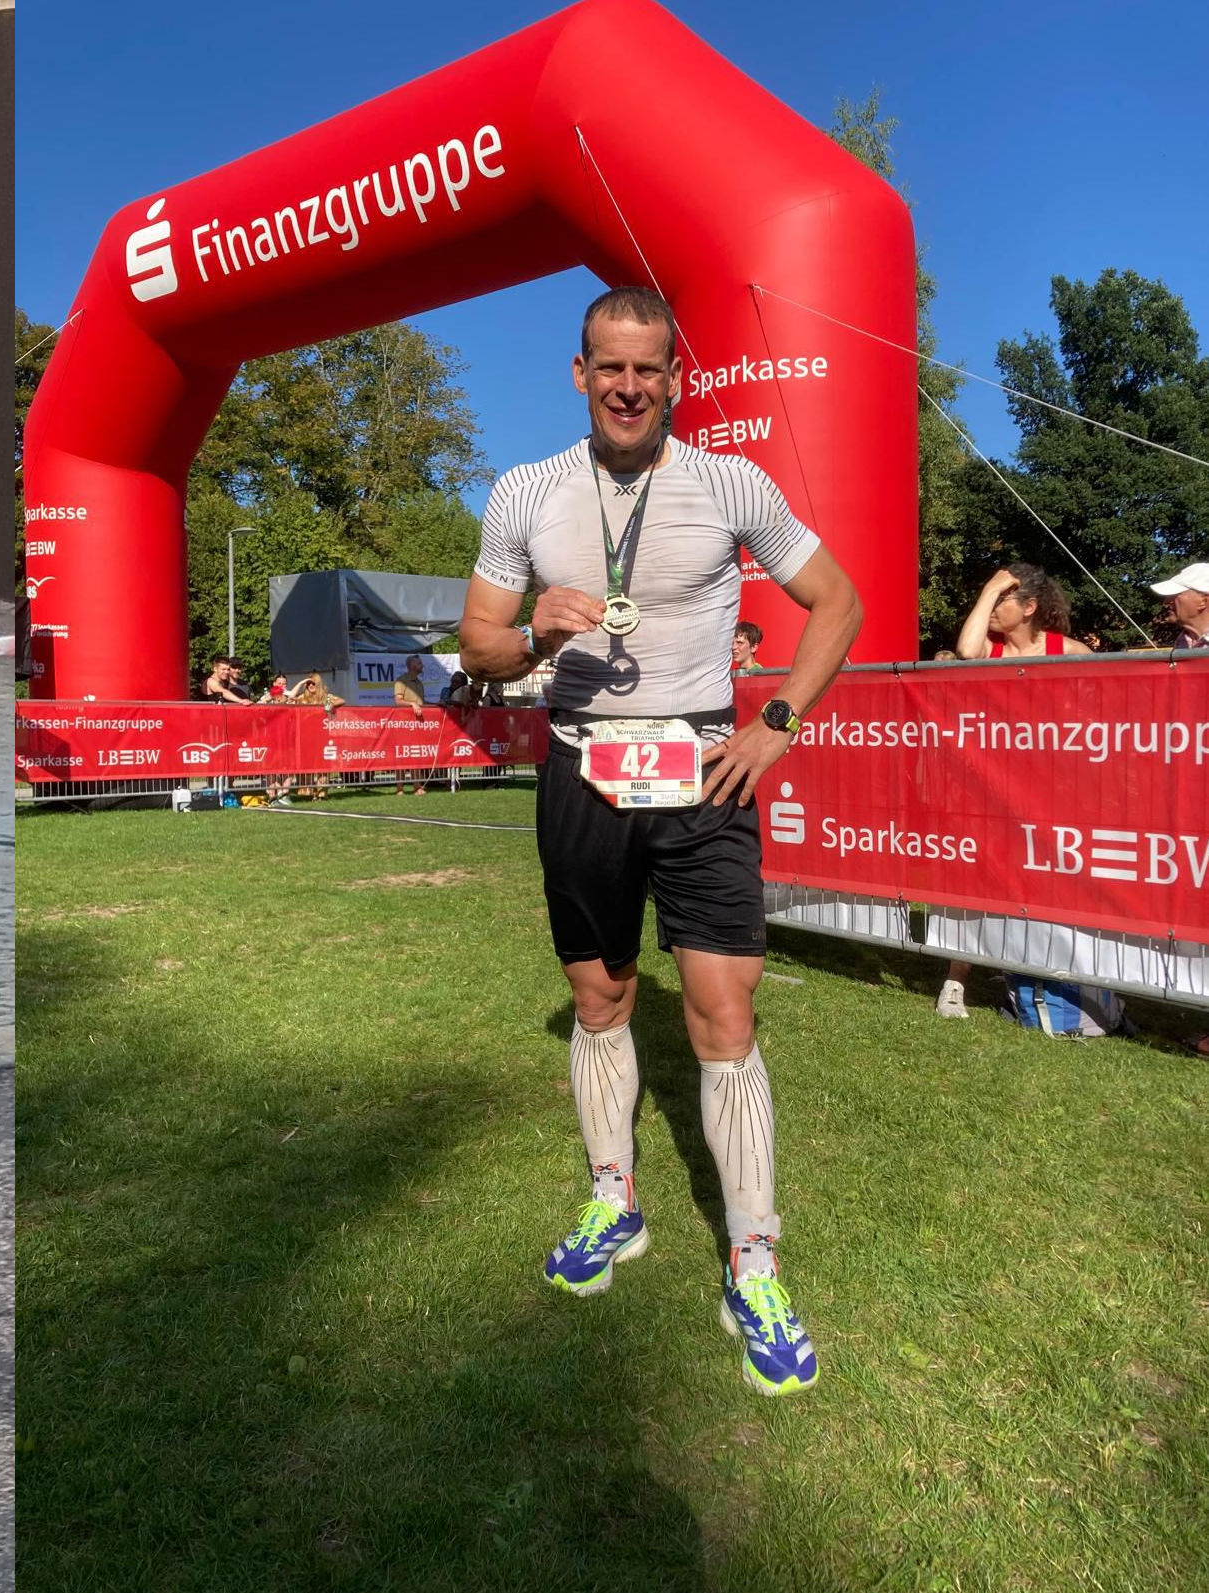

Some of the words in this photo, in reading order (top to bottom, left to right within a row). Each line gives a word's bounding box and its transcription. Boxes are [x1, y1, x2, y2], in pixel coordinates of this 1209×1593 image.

[191, 124, 506, 283] Finanzgruppe
[688, 354, 828, 400] Sparkasse
[356, 662, 395, 682] LTM
[322, 718, 440, 731] Sparkassen-Finanzgruppe
[786, 711, 1209, 765] arkassen-Finanzgrupp
[17, 754, 84, 768] Sparkasse
[182, 750, 211, 764] LBS
[341, 749, 387, 762] Sparkasse
[453, 745, 473, 757] LBS
[620, 743, 661, 778] 42
[630, 781, 651, 791] RUDI
[821, 817, 978, 864] Sparkasse
